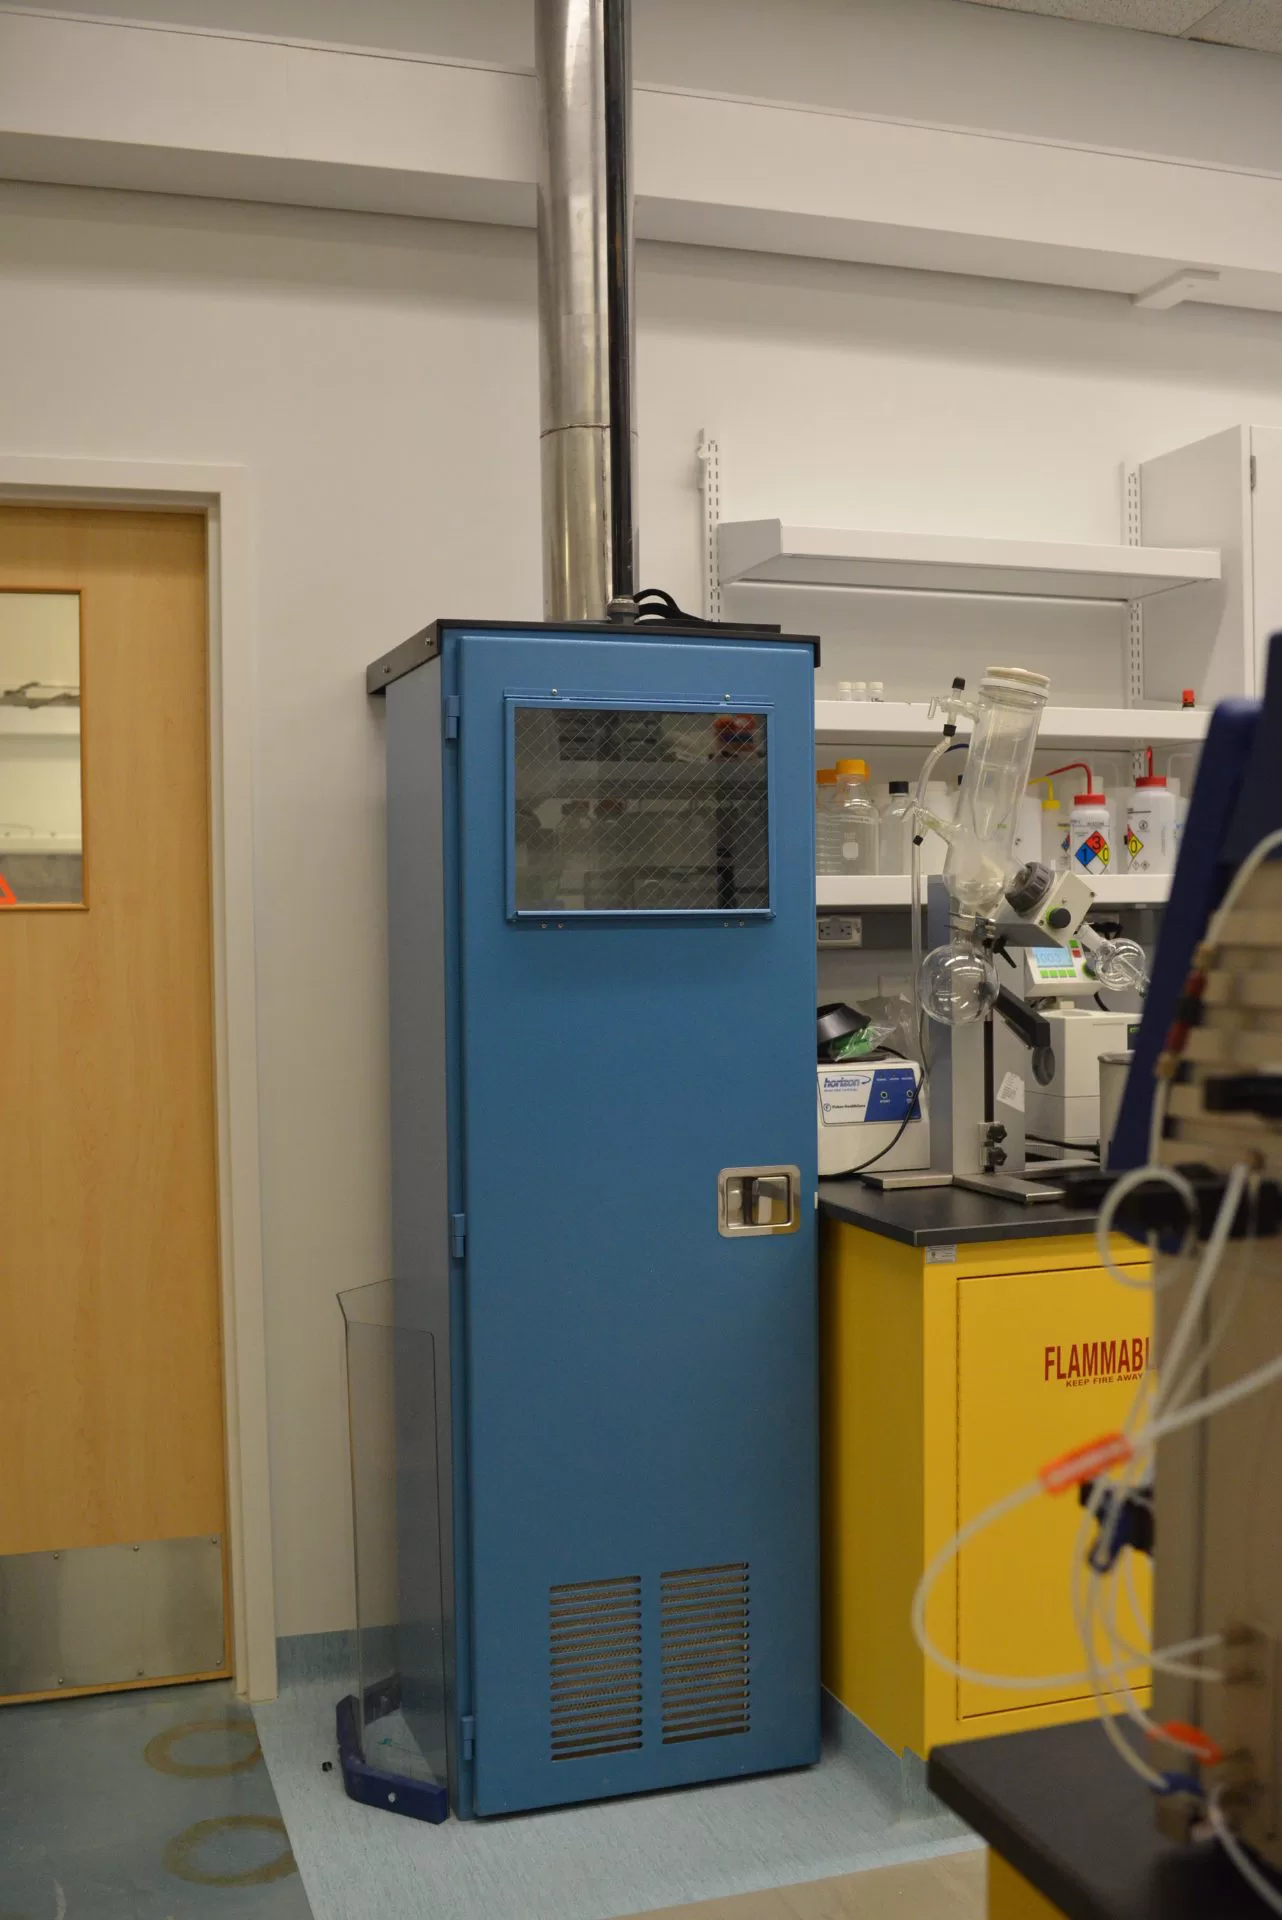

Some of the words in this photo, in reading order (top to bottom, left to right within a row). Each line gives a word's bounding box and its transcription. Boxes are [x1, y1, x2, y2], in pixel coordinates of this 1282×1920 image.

[1092, 836, 1101, 850] 3
[1130, 839, 1138, 853] 0
[1082, 847, 1088, 862] 1
[1103, 847, 1109, 862] 0
[824, 1076, 860, 1089] horizon
[1066, 1378, 1090, 1388] KEEP
[1093, 1376, 1114, 1385] FIRE
[1116, 1373, 1143, 1383] AWAY
